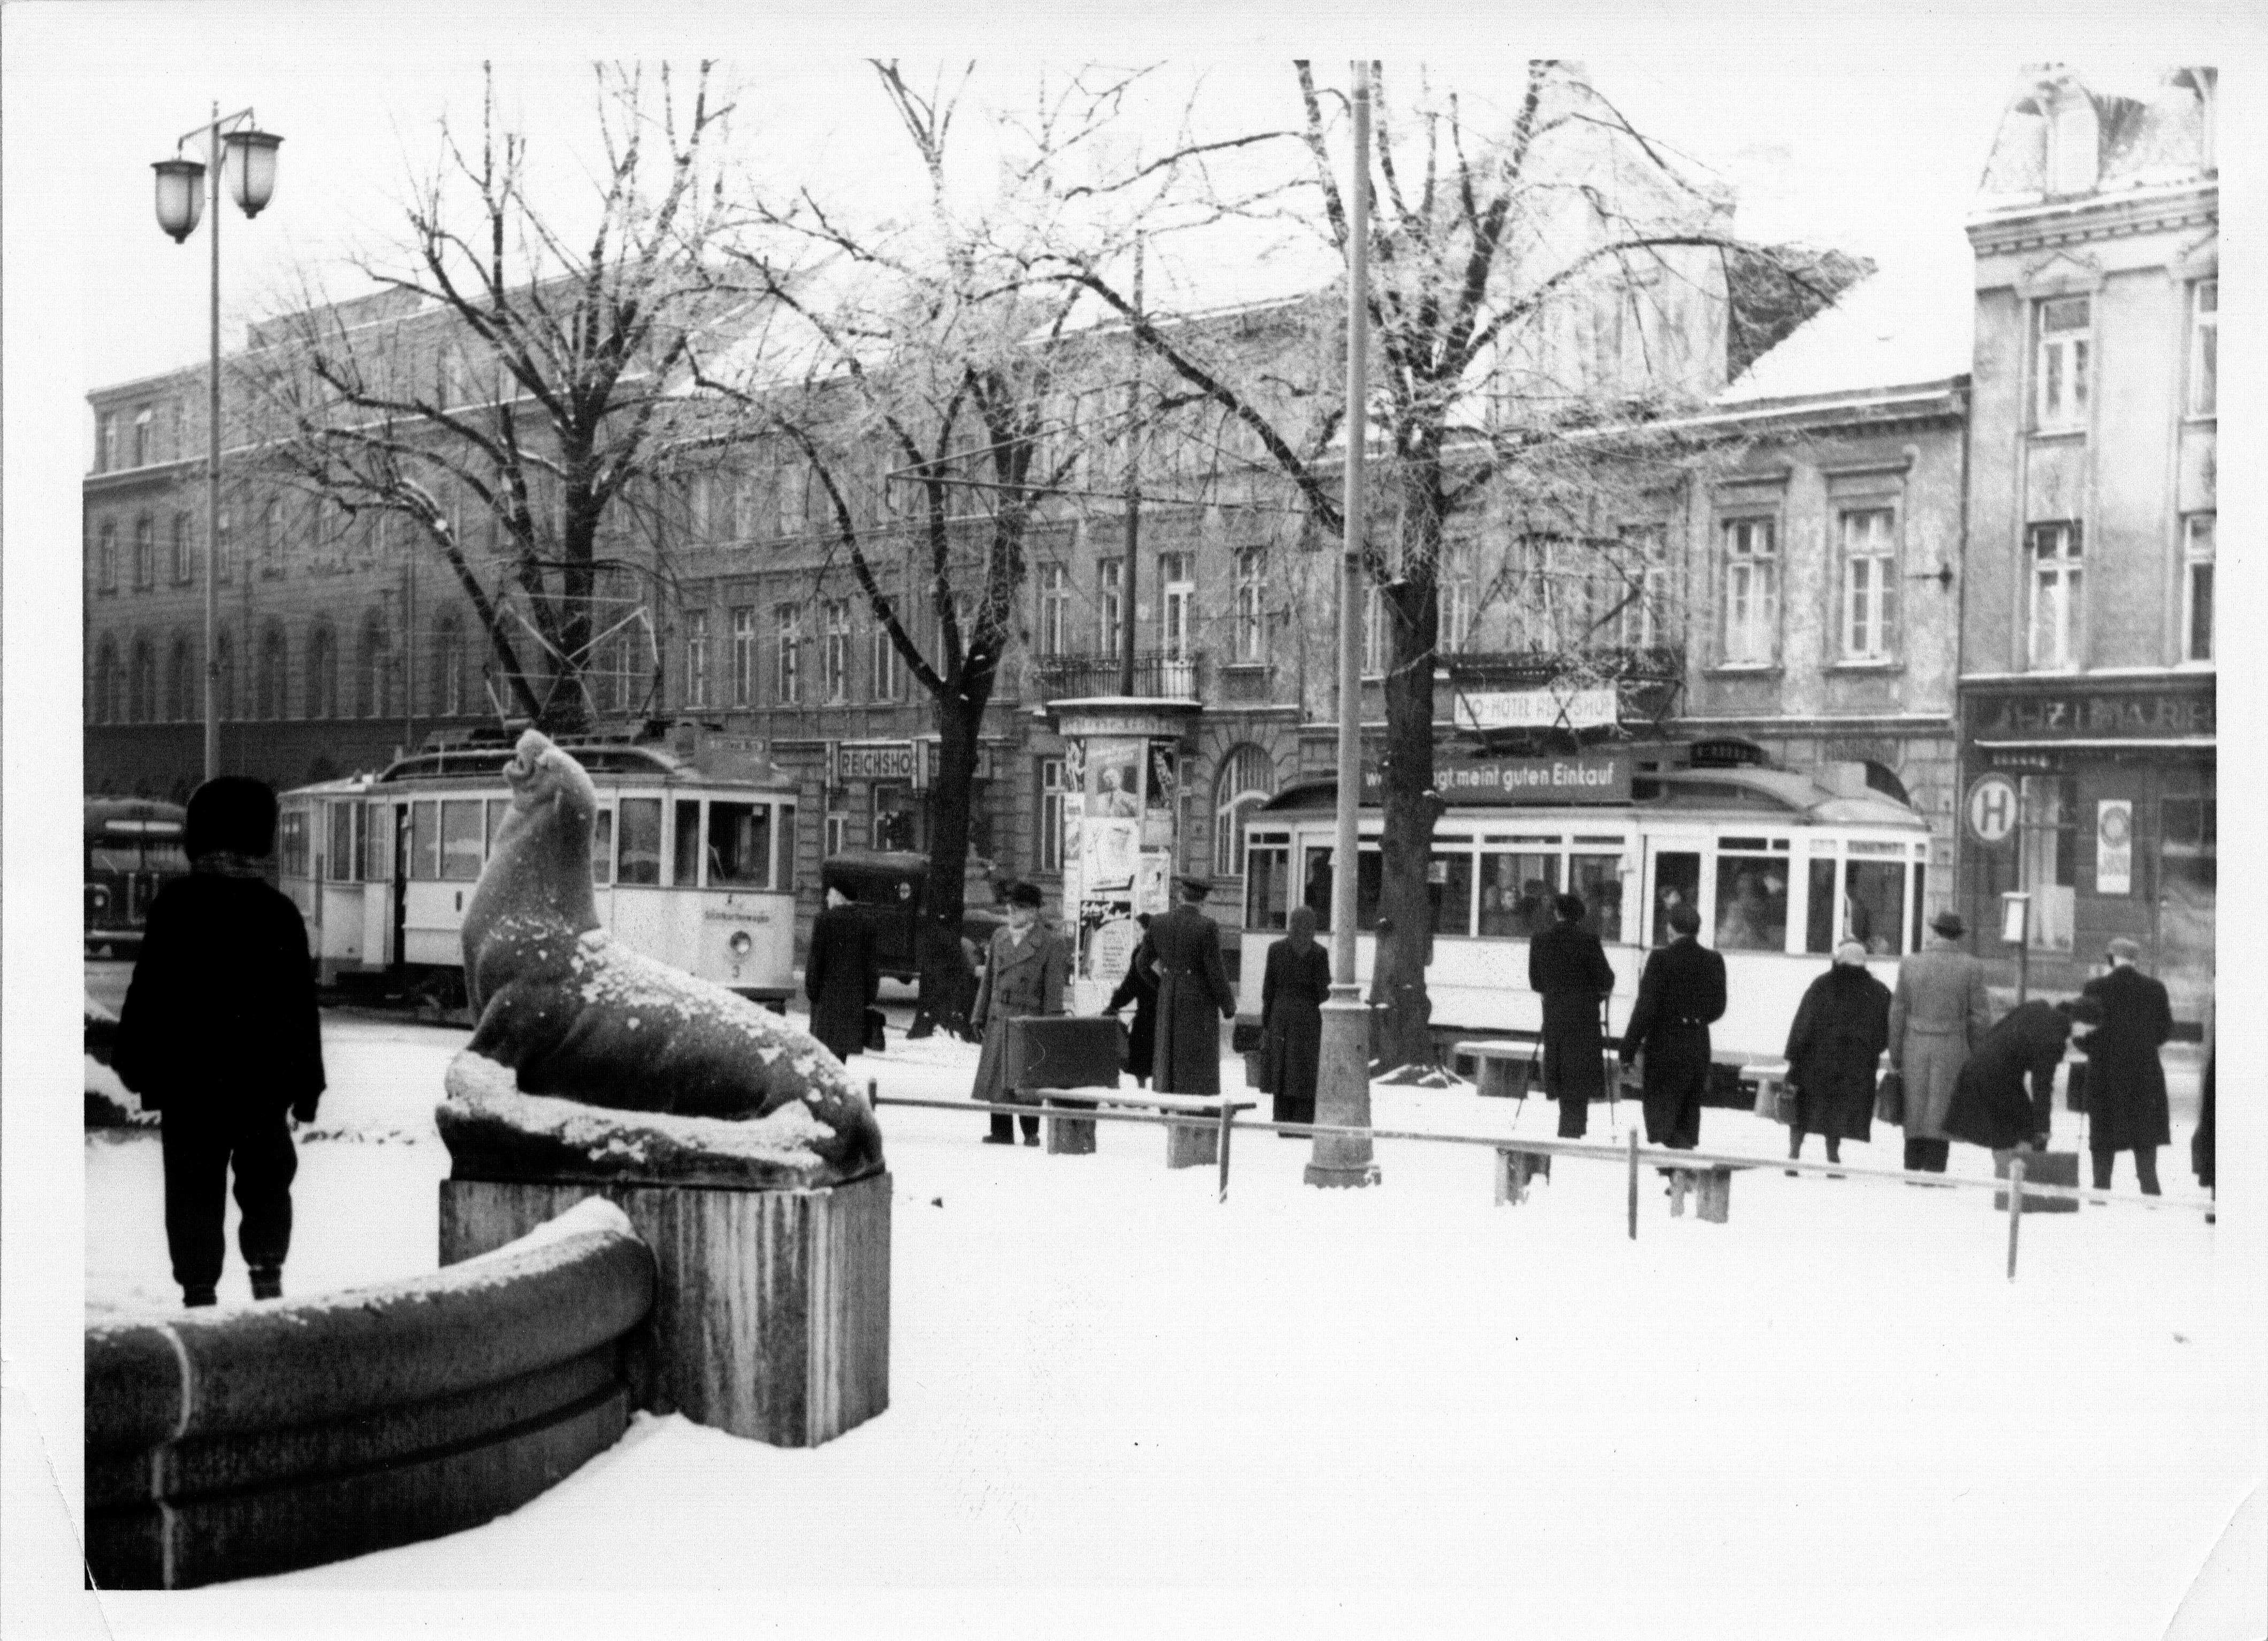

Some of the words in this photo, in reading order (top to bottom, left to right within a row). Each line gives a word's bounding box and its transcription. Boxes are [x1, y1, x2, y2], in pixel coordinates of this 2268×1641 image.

[1433, 767, 1455, 792] gt
[1456, 765, 1500, 787] meint
[1502, 767, 1548, 792] guten
[1552, 762, 1614, 787] Einkauf
[1981, 790, 2007, 831] H
